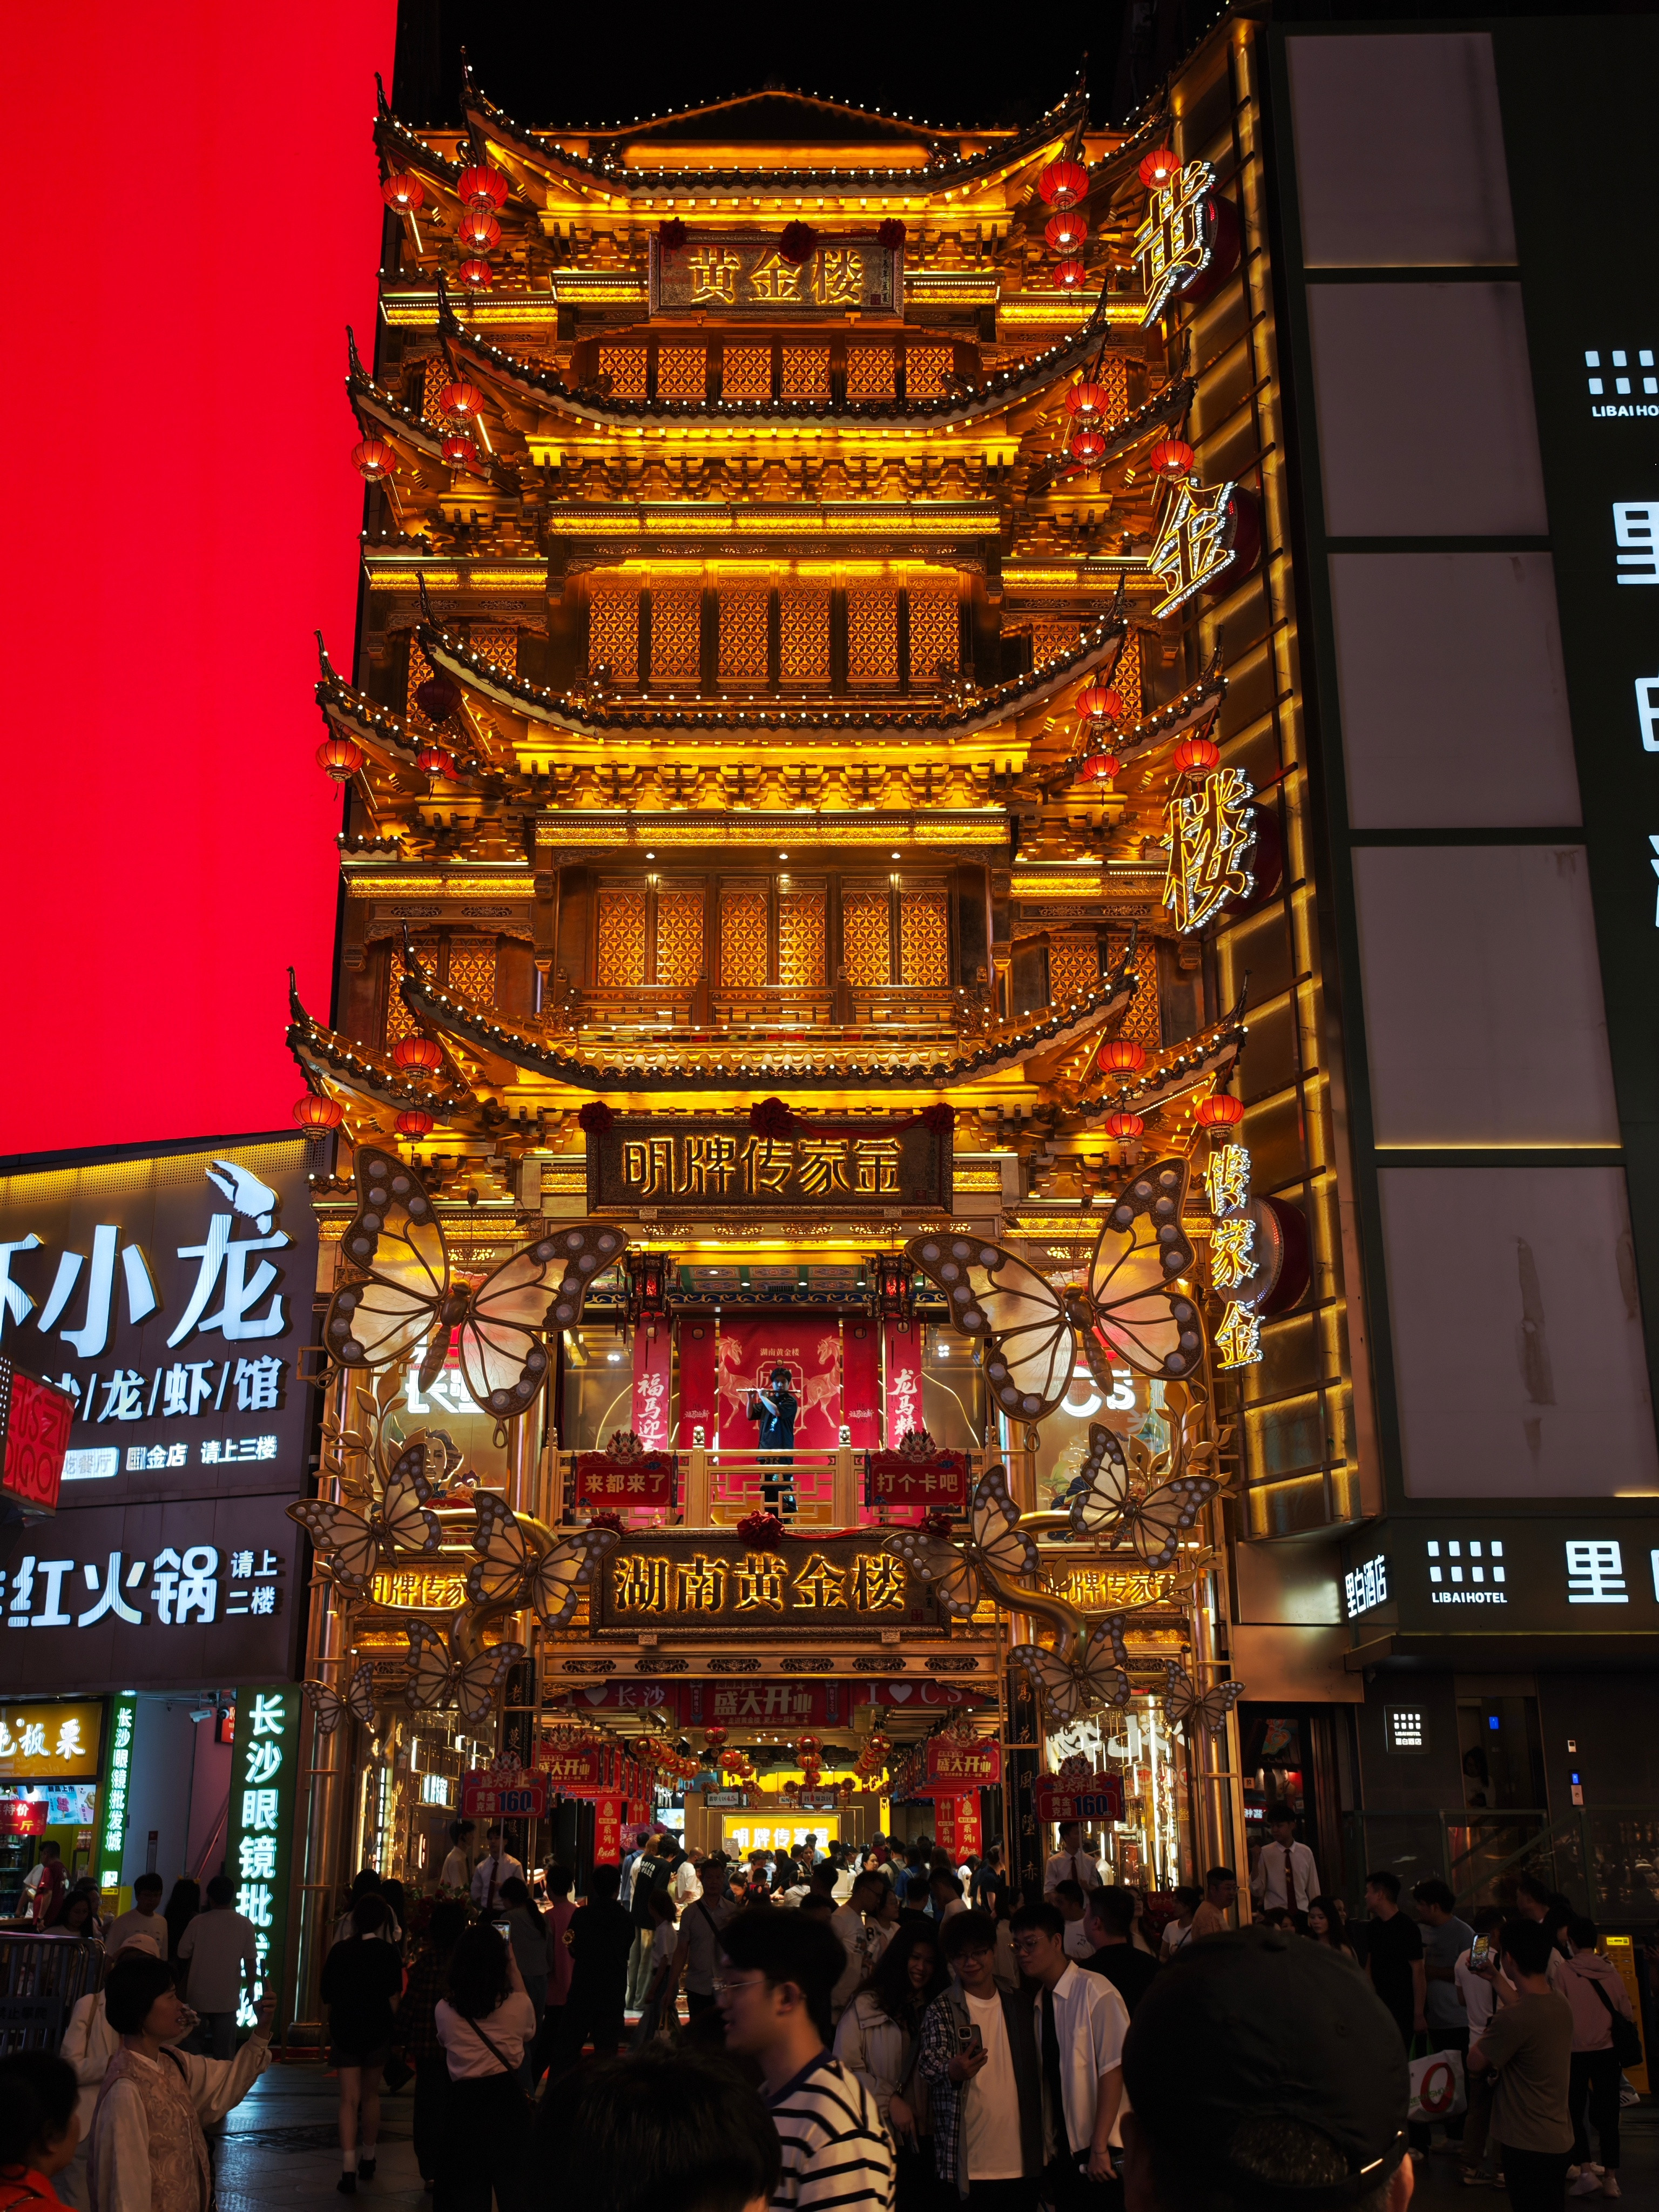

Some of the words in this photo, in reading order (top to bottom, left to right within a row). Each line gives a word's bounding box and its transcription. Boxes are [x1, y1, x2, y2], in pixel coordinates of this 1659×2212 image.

[688, 247, 864, 305] 黄金楼
[623, 1135, 903, 1196] 明牌传家金
[760, 1348, 800, 1357] 湖南黄金楼
[887, 1368, 922, 1449] 龙马精
[200, 1434, 277, 1465] 请上三楼
[585, 1474, 665, 1493] 来都来了
[877, 1473, 959, 1493] 打个卡吧
[230, 1549, 278, 1579] 请上
[0, 1546, 218, 1627] 红火锅
[615, 1554, 907, 1612] 湖南黄金楼
[1345, 1554, 1387, 1618] 里白酒店
[226, 1586, 275, 1615] 二楼
[615, 1685, 666, 1707] 长沙
[713, 1685, 813, 1716] 盛大开业
[867, 1683, 879, 1705] I
[538, 1758, 590, 1776] 盛大开业
[936, 1756, 992, 1772] 盛大开业
[105, 1707, 133, 1852] 长沙眼镜批发城
[476, 1791, 496, 1801] 黄金
[497, 1790, 532, 1812] 160
[1051, 1797, 1071, 1806] 黄金
[1073, 1794, 1109, 1817] 160
[603, 1825, 612, 1844] 系列
[732, 1827, 829, 1848] 明牌传家金
[964, 1824, 972, 1843] 系列
[236, 1694, 285, 2027] 长沙眼镜批
